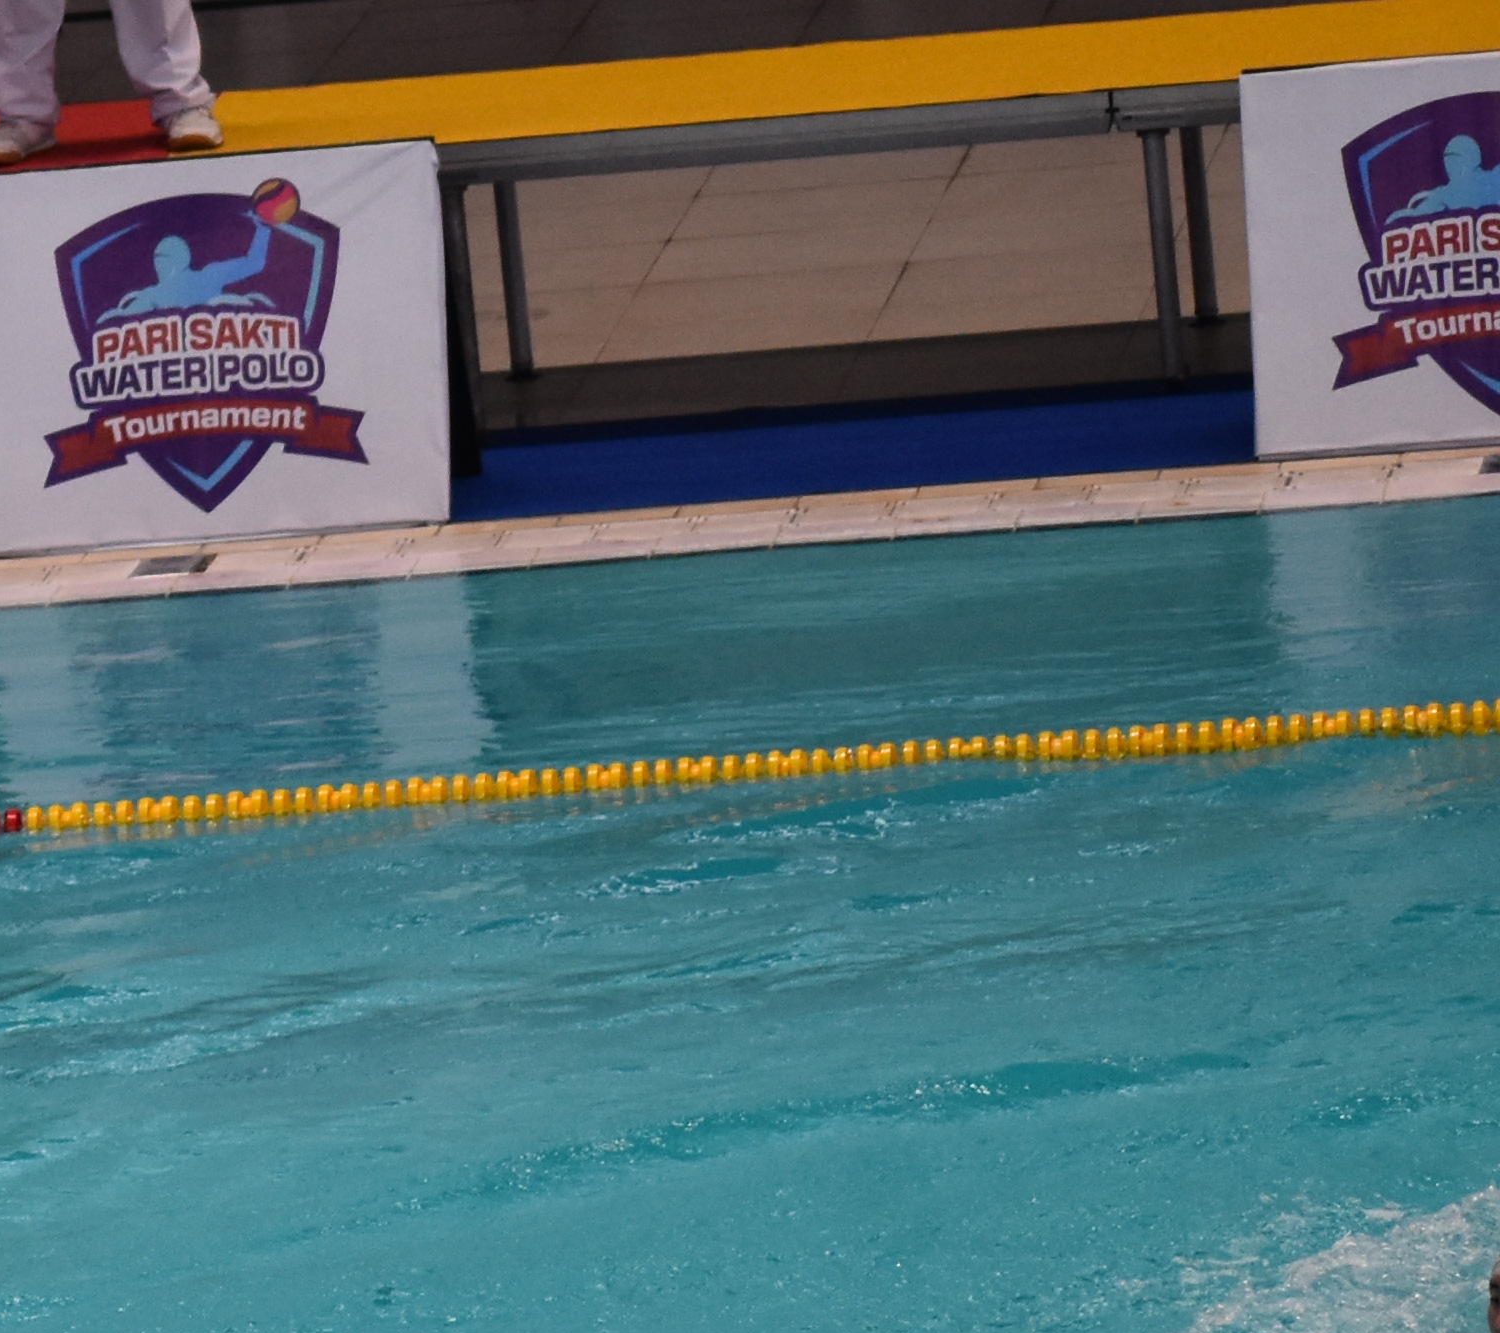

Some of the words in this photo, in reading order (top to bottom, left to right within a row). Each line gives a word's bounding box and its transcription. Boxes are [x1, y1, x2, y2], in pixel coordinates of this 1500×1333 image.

[1386, 221, 1470, 264] PARI
[1369, 257, 1500, 299] WATER
[97, 320, 180, 363] PARI
[189, 318, 296, 350] SAKTI
[81, 355, 208, 398] WATER
[217, 352, 315, 387] POLO
[103, 406, 307, 443] Tournament
